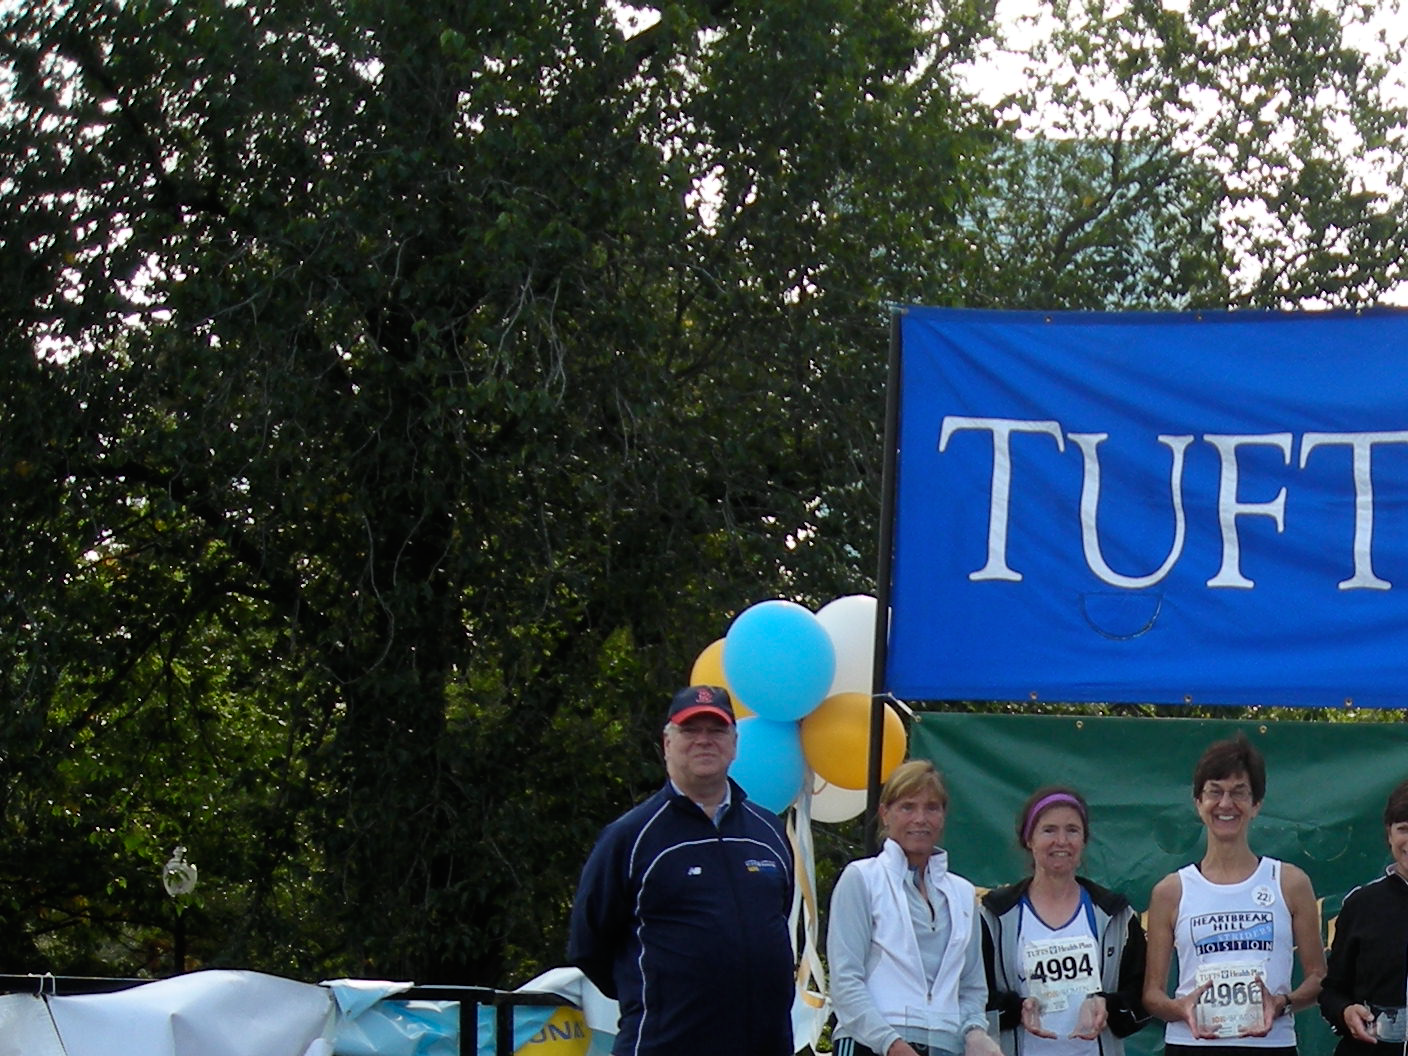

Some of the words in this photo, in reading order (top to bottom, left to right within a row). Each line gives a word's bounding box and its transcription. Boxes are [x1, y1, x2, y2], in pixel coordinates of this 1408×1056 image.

[1193, 913, 1269, 926] HEARTBREAK
[1213, 922, 1245, 931] HILL
[1030, 953, 1093, 983] 4994
